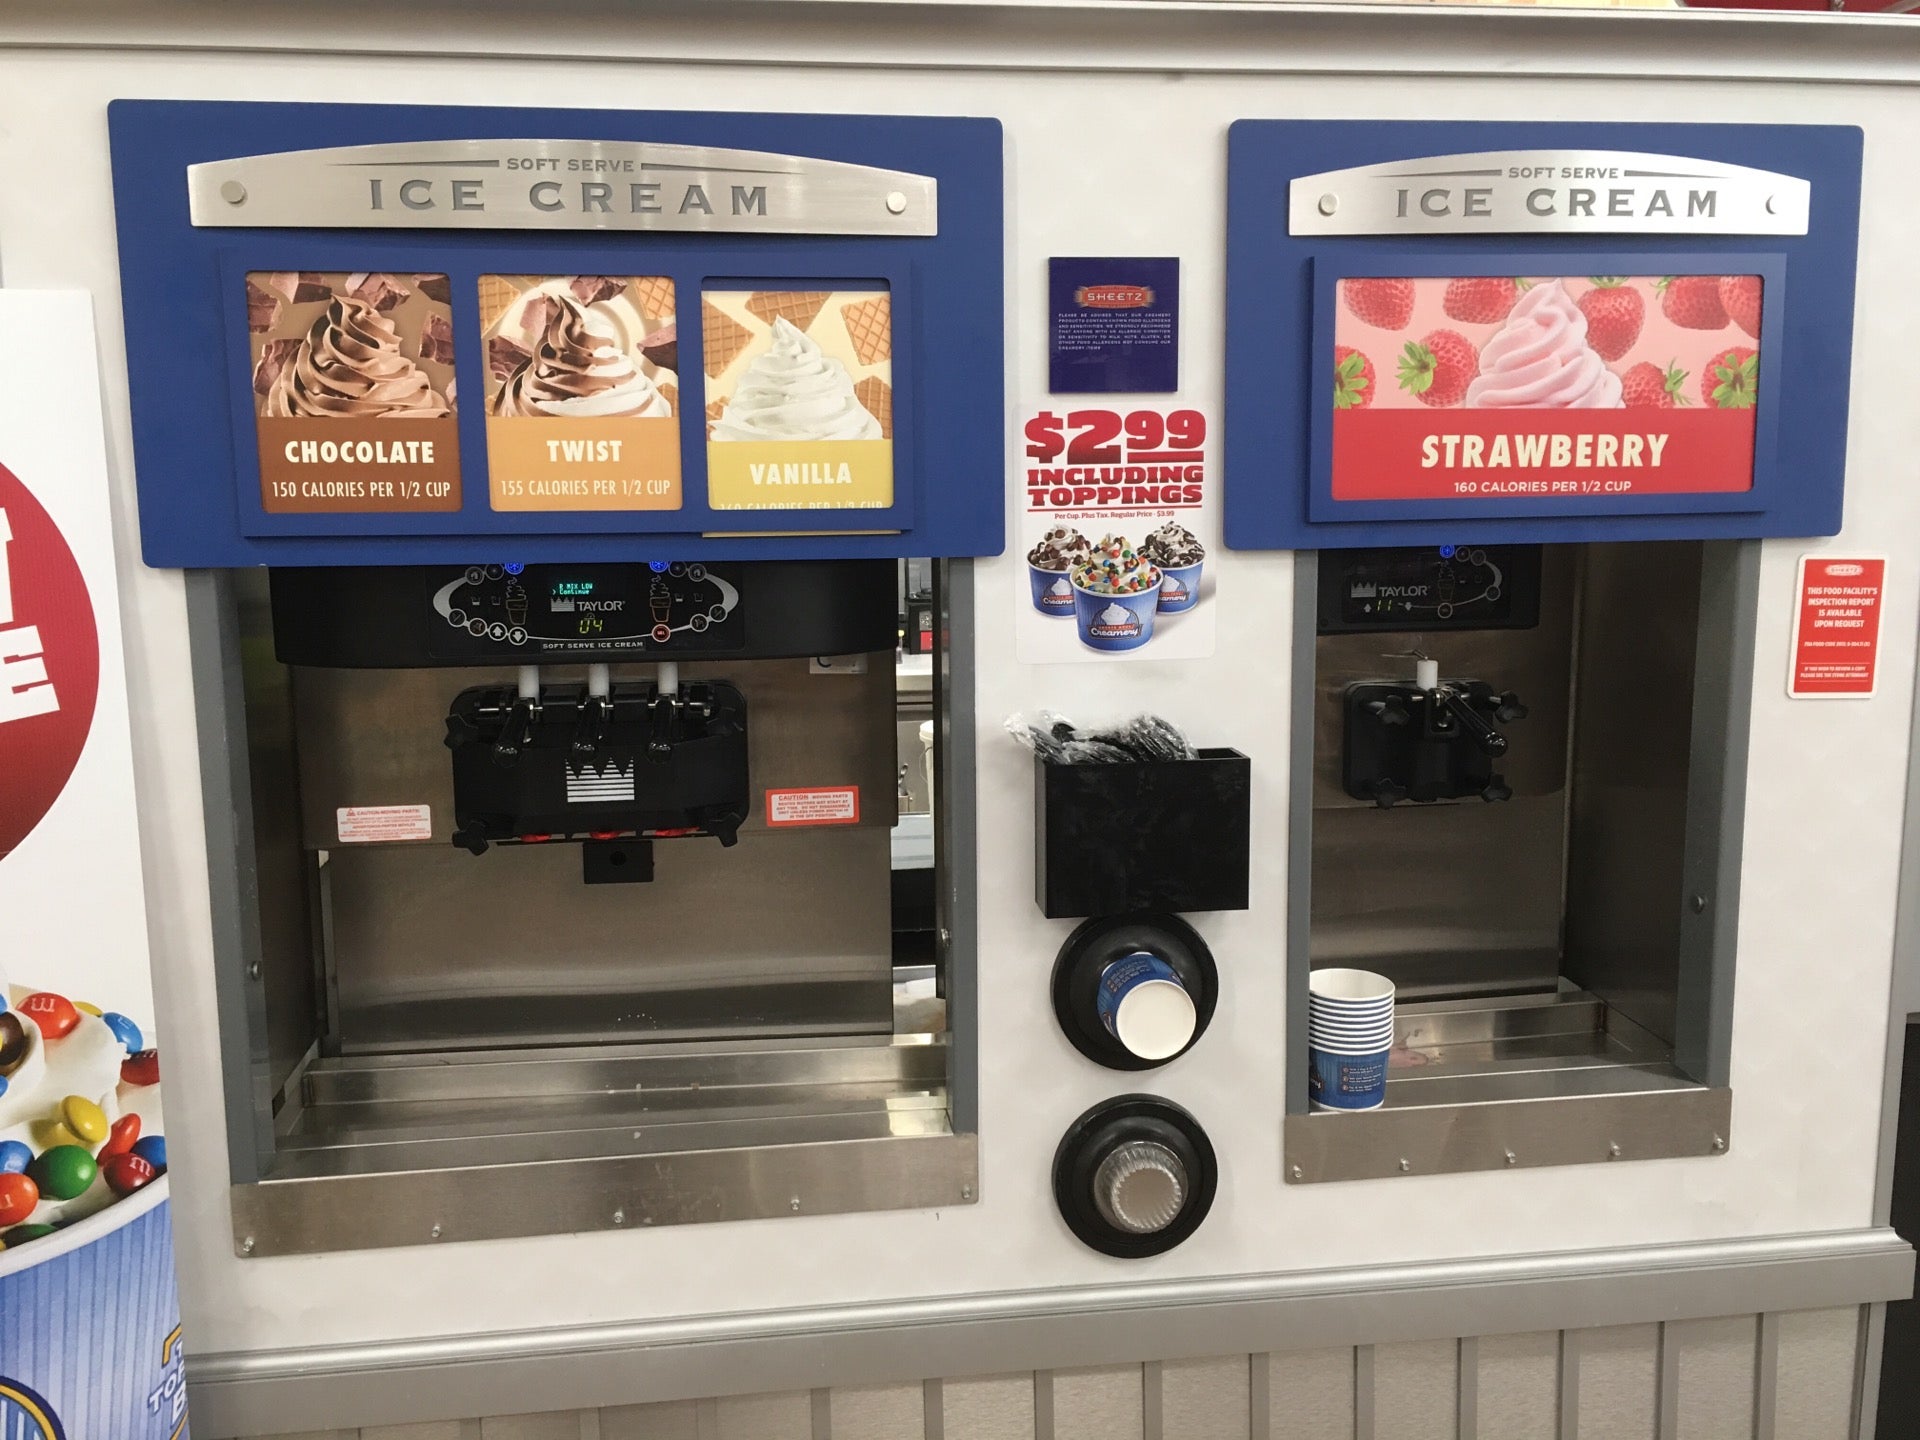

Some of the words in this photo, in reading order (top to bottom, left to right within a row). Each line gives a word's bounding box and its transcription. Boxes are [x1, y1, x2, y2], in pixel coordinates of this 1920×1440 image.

[507, 158, 560, 171] SOFT
[568, 159, 634, 172] SERVE
[1509, 167, 1555, 178] SOFT
[1561, 168, 1619, 178] SERVE
[369, 179, 485, 211] ICE
[529, 181, 768, 216] CREAM
[1396, 188, 1493, 218] ICE
[1526, 188, 1717, 217] CREAM
[285, 441, 434, 463] CHOCOLATE
[547, 440, 622, 462] TWIST
[1421, 434, 1669, 468] STRAWBERRY
[750, 463, 852, 484] VANILLA
[1027, 466, 1204, 486] INCLUDING
[272, 481, 296, 497] 150
[302, 481, 365, 497] CALORIES
[370, 481, 394, 497] PER
[400, 481, 420, 499] 1/2
[426, 482, 451, 497] CUP
[501, 480, 523, 495] 155
[529, 480, 588, 495] CALORIES
[593, 480, 616, 495] PER
[623, 480, 642, 495] 1/2
[647, 480, 670, 495] CUP
[1454, 481, 1477, 492] 160
[1481, 481, 1548, 492] CALORIES
[1552, 481, 1577, 492] PER
[1582, 481, 1601, 492] 1/2
[1605, 481, 1632, 492] CUP
[1027, 485, 1203, 506] TOPPINGS
[1110, 511, 1135, 519] Regular
[1379, 585, 1428, 597] TAYLOR
[577, 601, 623, 611] TAYLOR
[1043, 597, 1074, 605] Creame
[1808, 598, 1848, 606] INSPECTION
[1849, 598, 1875, 606] REPORT
[579, 619, 603, 634] 04
[1090, 627, 1138, 636] Creamery
[1814, 620, 1834, 628] UPON
[1835, 620, 1864, 628] REQUEST
